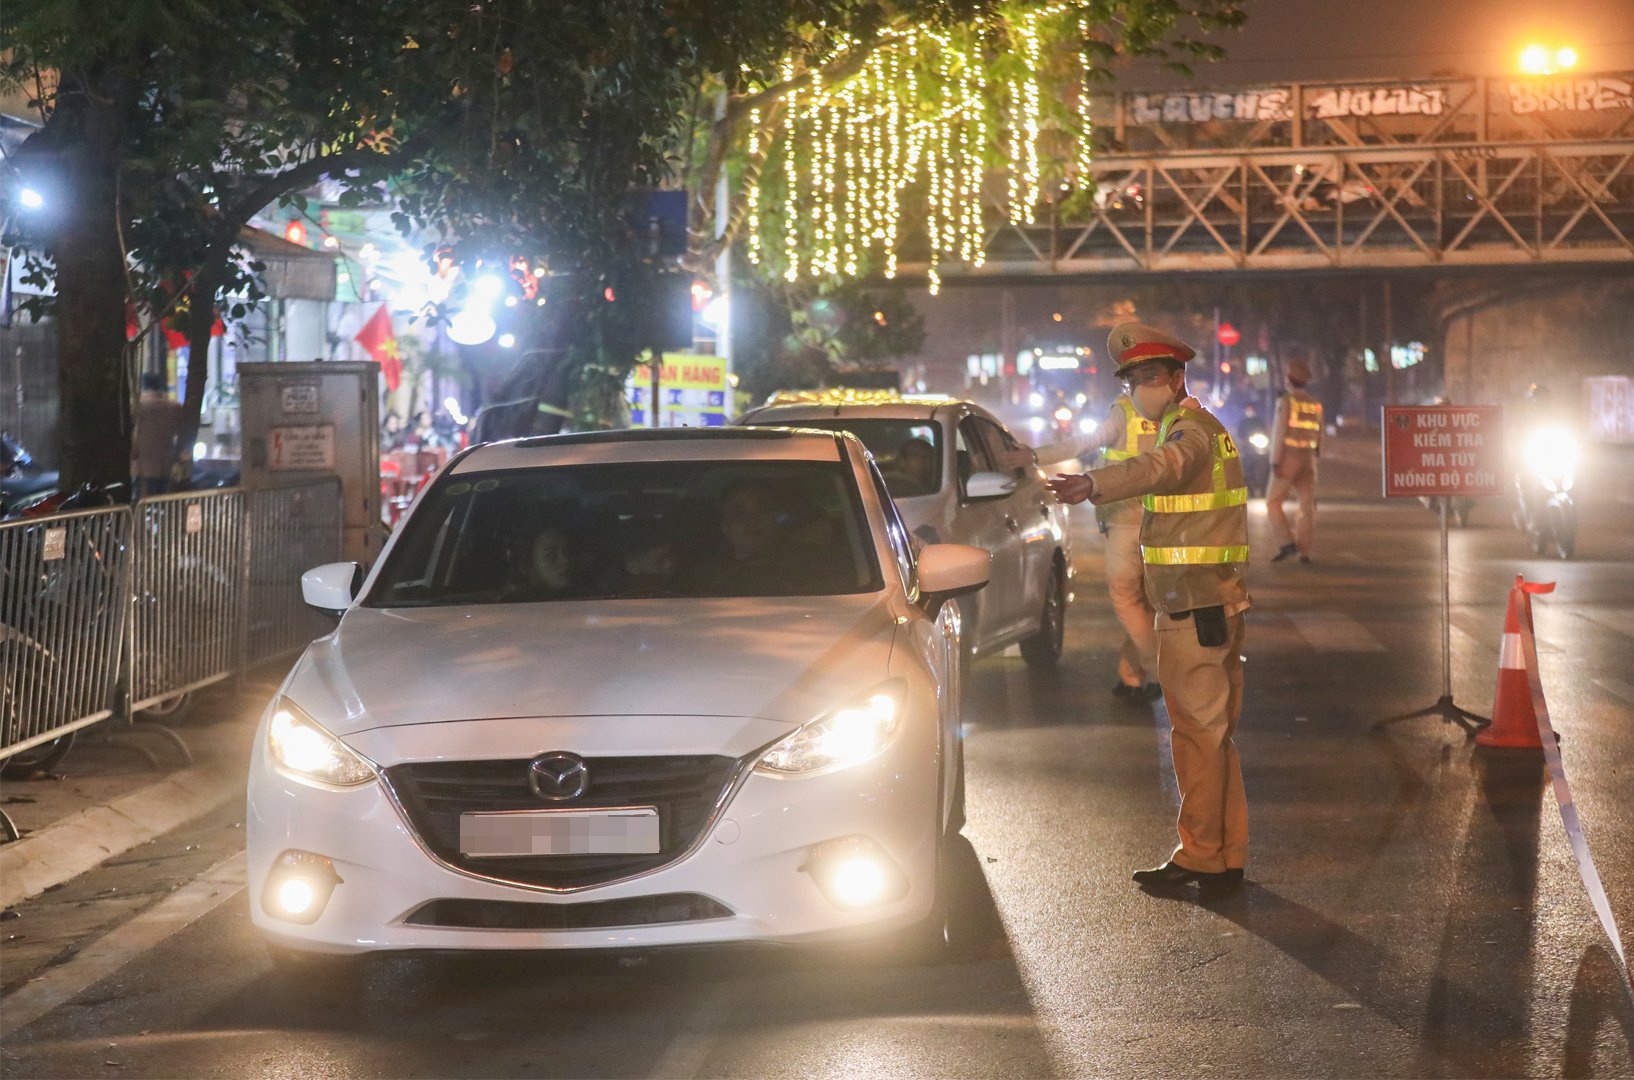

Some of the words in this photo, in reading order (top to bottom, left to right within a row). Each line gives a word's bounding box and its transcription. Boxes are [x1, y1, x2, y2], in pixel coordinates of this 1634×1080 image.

[1417, 414, 1447, 428] KHU
[1451, 412, 1481, 430] VỰC
[1413, 428, 1451, 447] KIỂM
[1456, 433, 1483, 447] TRA
[1421, 453, 1446, 467] MA
[1394, 468, 1436, 487] NỒNG
[1440, 469, 1460, 489] ĐỘ
